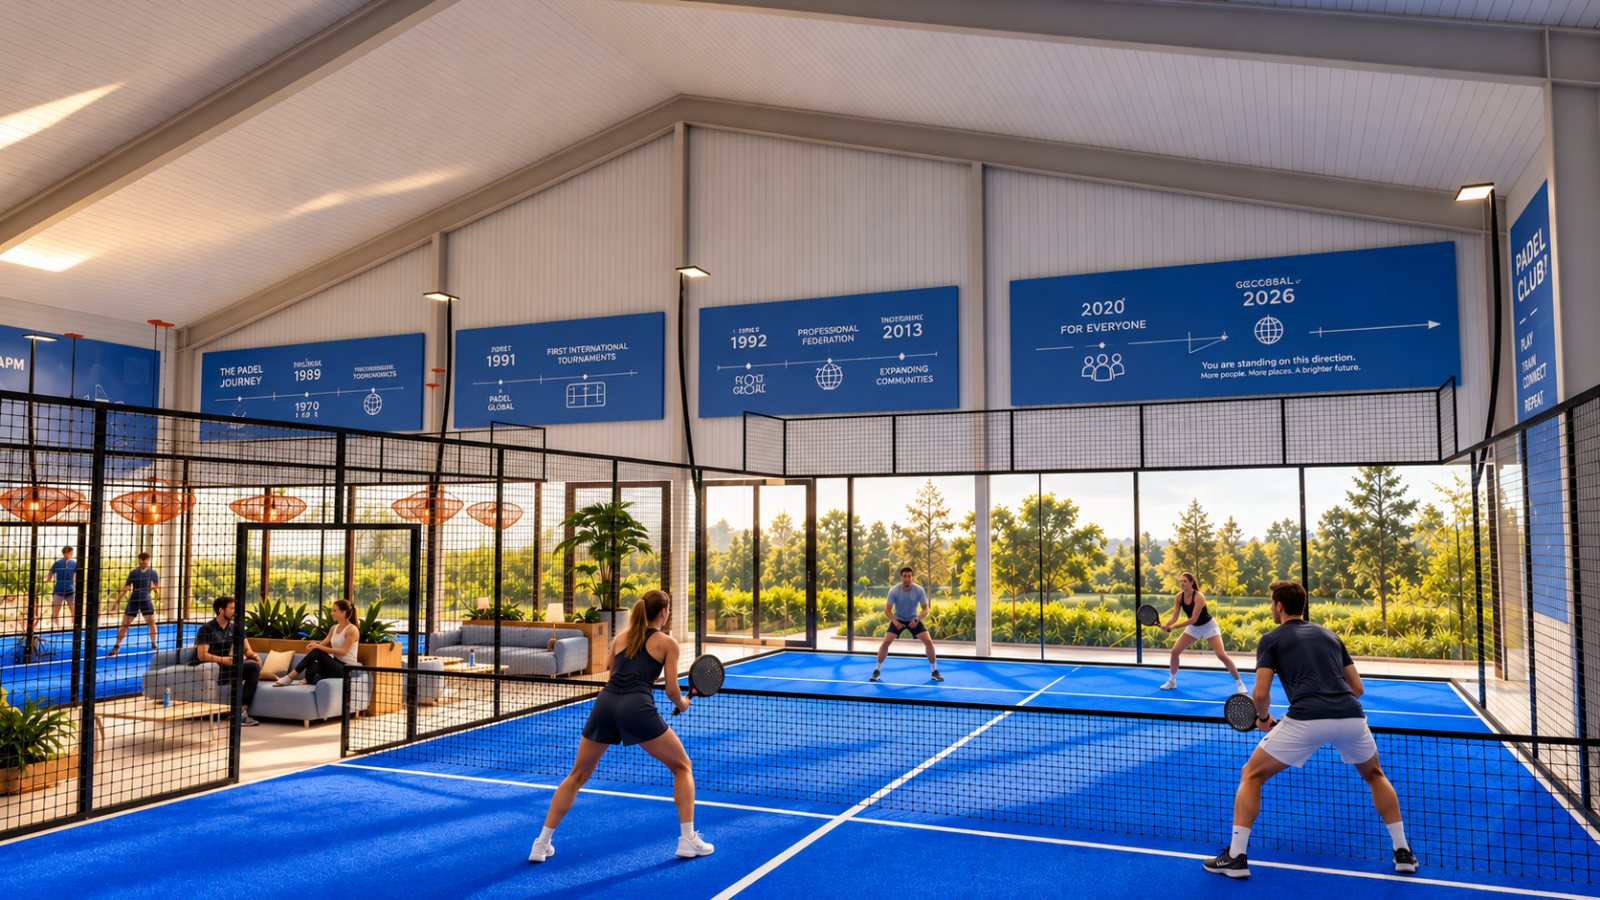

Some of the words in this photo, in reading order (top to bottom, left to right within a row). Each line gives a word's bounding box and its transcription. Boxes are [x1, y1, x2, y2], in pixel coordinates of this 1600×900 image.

[1515, 228, 1546, 276] PADEL
[1243, 288, 1295, 307] 2026
[797, 324, 860, 336] PROFESSIONAL
[883, 323, 923, 339] 2013
[1060, 325, 1083, 334] FOR
[1086, 319, 1147, 333] EVERYONE
[730, 334, 767, 349] 1992
[802, 334, 855, 346] FEDERATION
[1520, 330, 1534, 352] PLAY
[547, 347, 567, 356] FIRST
[569, 342, 629, 353] INTERNATIONAL
[486, 353, 516, 368] 1991
[557, 352, 616, 365] TOURNAMENTS
[1201, 361, 1219, 370] You
[1220, 361, 1235, 369] are
[1237, 358, 1277, 368] standing
[1278, 358, 1291, 366] on
[1293, 356, 1310, 365] this
[1311, 353, 1356, 364] direction.
[220, 366, 236, 376] THE
[237, 364, 263, 375] PADEL
[294, 368, 322, 382] 1989
[879, 365, 929, 376] EXPANDING
[1248, 369, 1268, 377] More
[1302, 365, 1333, 375] brighter
[1522, 362, 1547, 389] CONNECT
[220, 376, 263, 389] JOURNEY
[876, 375, 934, 386] COMMUNITIES
[488, 395, 512, 403] PADEL
[1524, 390, 1544, 413] REPEAT
[295, 401, 320, 412] 1970
